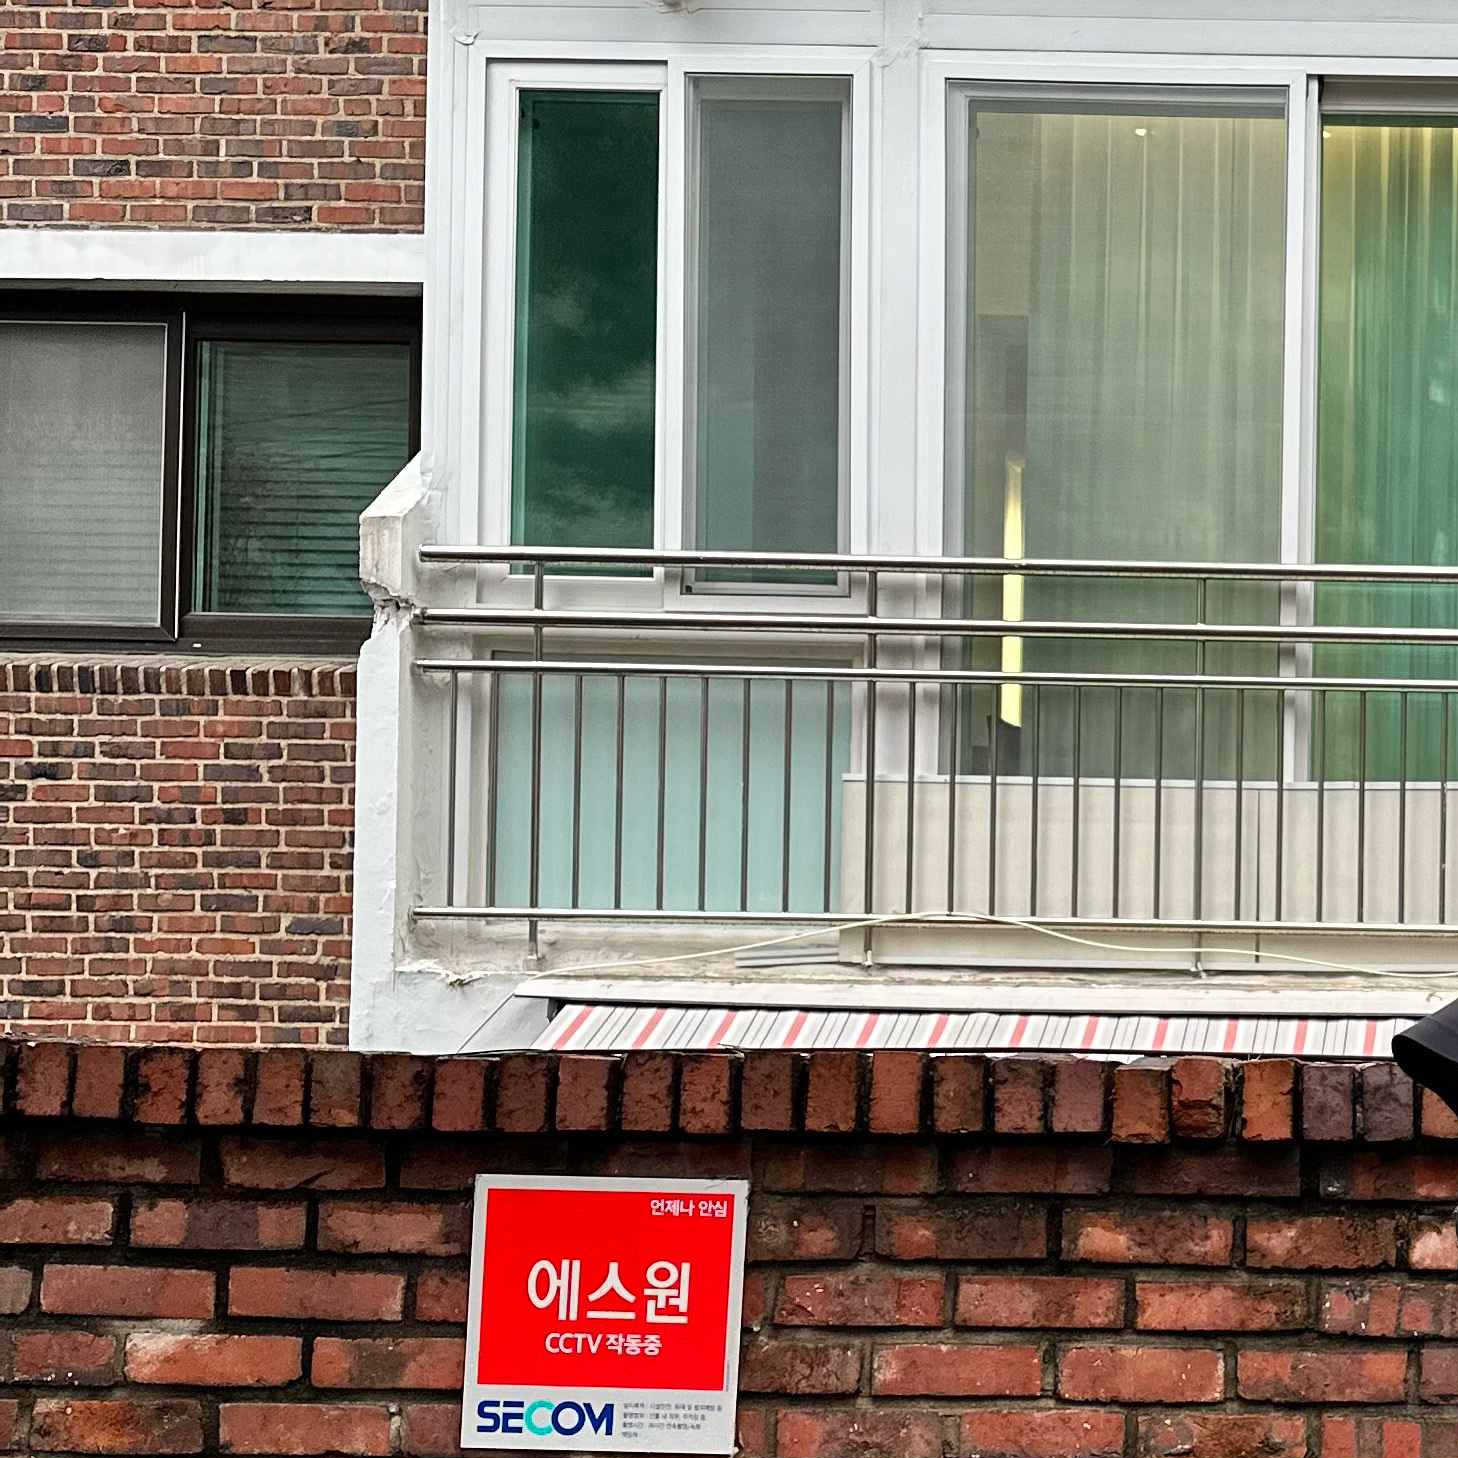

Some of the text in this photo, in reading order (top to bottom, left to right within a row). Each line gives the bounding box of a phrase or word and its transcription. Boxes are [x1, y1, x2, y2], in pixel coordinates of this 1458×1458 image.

[650, 1199, 728, 1218] 언제나 안심
[527, 1258, 691, 1324] 에스원
[545, 1332, 663, 1356] CCTV 작동중
[476, 1400, 614, 1436] SECOM
